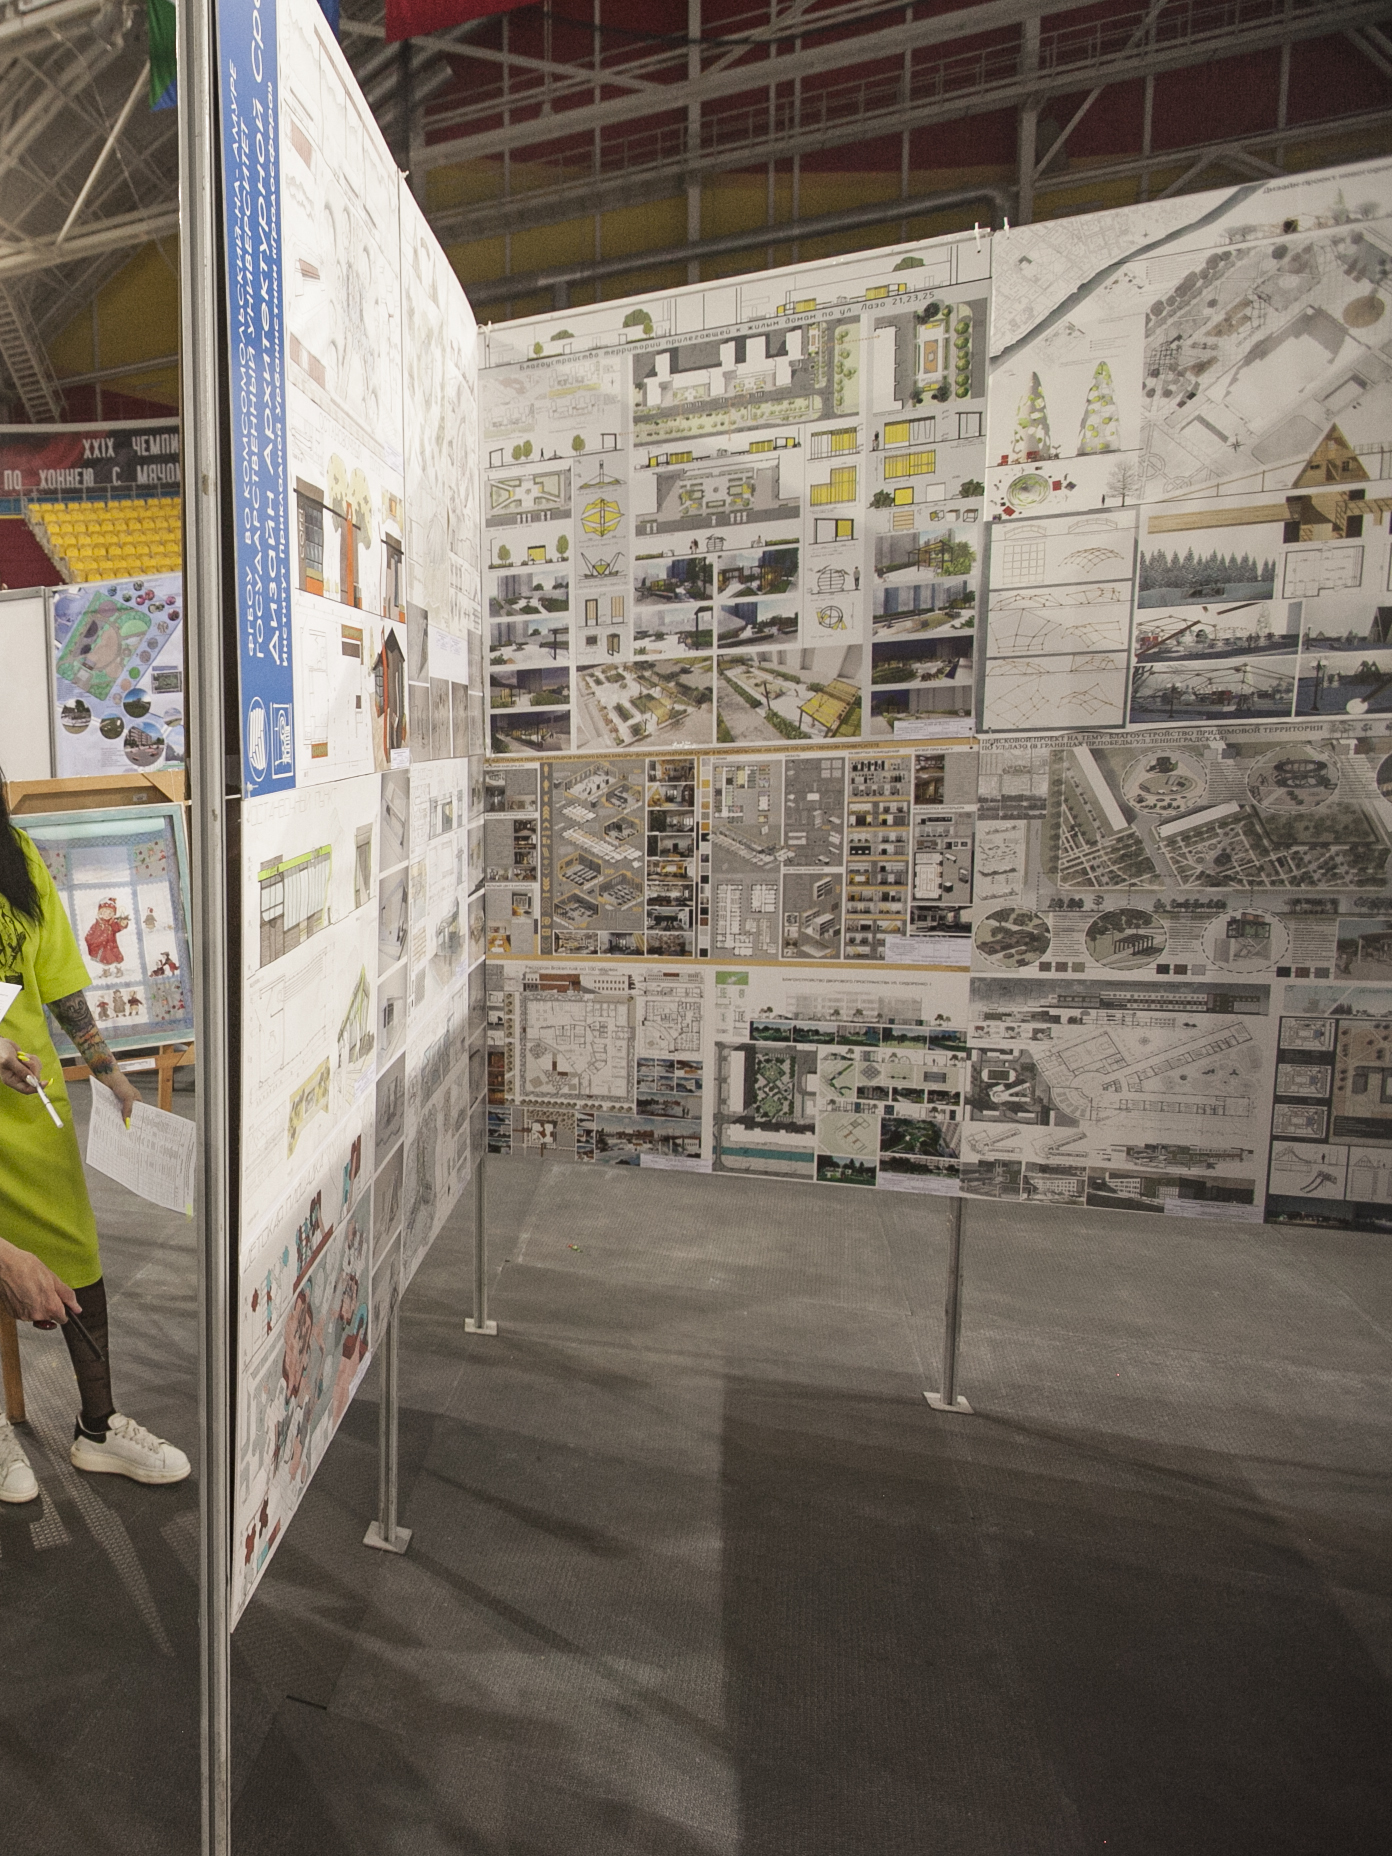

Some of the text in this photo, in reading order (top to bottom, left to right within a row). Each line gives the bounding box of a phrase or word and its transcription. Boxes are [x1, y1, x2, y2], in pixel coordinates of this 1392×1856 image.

[228, 58, 241, 161] АМУРЕ
[251, 97, 276, 475] Архитектурной
[518, 351, 599, 373] Благоустройство
[603, 340, 661, 358] территории
[664, 327, 732, 347] прилегающей
[746, 319, 780, 331] жилым
[784, 313, 817, 326] домам
[821, 310, 834, 319] по
[860, 301, 886, 312] Лазо
[892, 290, 935, 306] 21,23,25
[239, 118, 264, 658] ГОСУДАРСТВЕННЫЙ УНИВЕРСИТЕТ
[271, 264, 285, 418] Урбанистики
[3, 469, 22, 490] ПО
[38, 467, 95, 490] ХОККЕЮ
[82, 437, 115, 459] XXIX
[275, 422, 286, 559] Прикладной
[243, 508, 253, 544] ВО
[246, 566, 255, 657] ФГБОУ
[264, 490, 281, 665] Дизайн
[278, 564, 288, 667] Институт
[1033, 735, 1065, 743] ПРОЕКТ
[1066, 734, 1079, 742] НА
[1109, 729, 1193, 740] БЛАГОУСТРОЙСТВО
[1195, 726, 1261, 737] ПРИДОМОВОЙ
[1262, 724, 1323, 734] ТЕРРИТОРИИ
[1040, 740, 1083, 748] ГРАНИЦАХ
